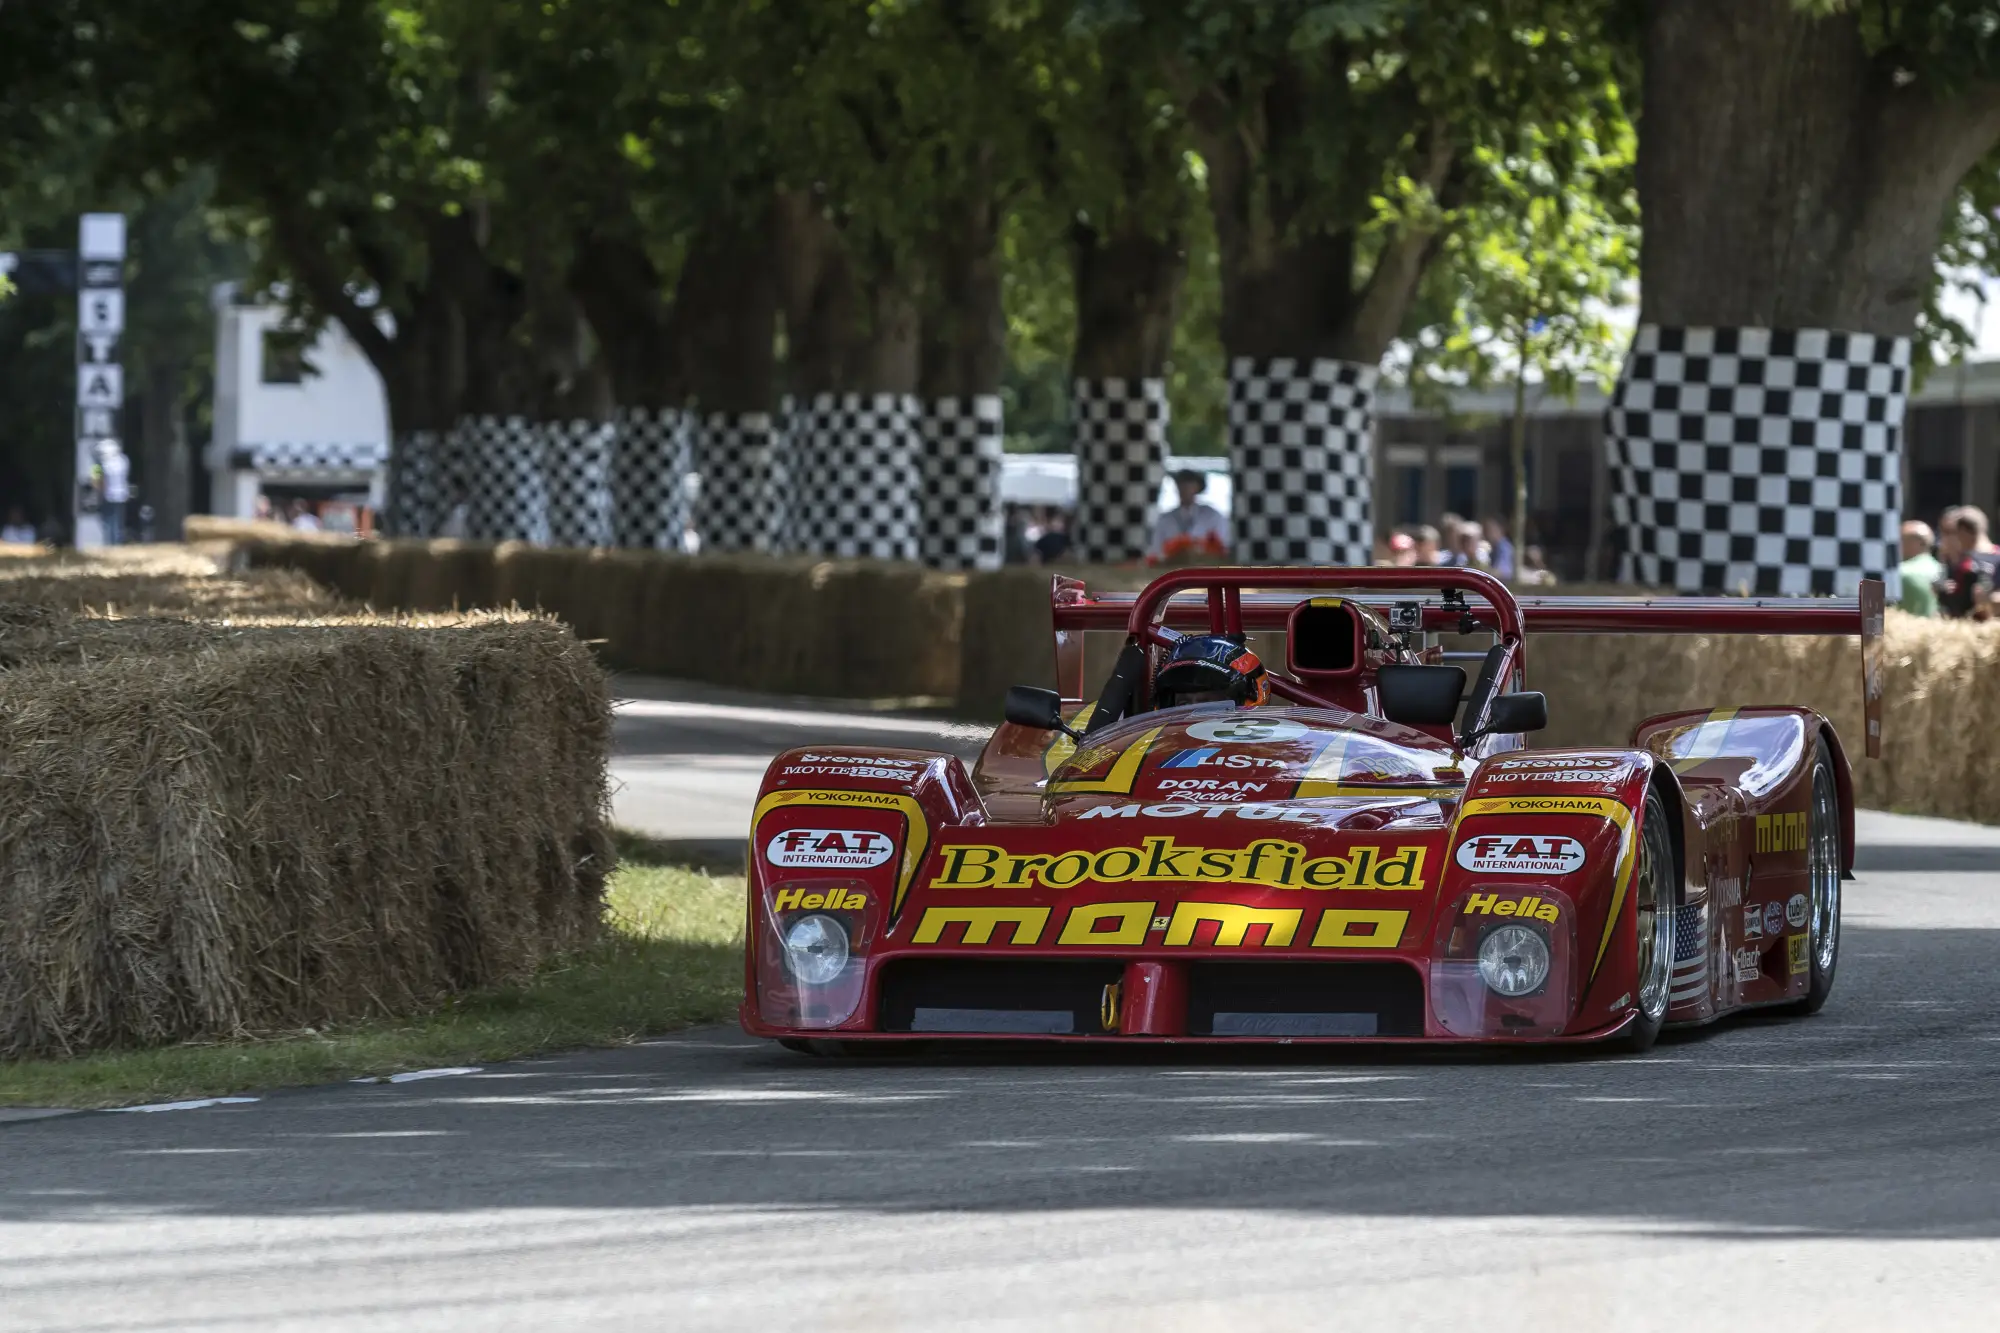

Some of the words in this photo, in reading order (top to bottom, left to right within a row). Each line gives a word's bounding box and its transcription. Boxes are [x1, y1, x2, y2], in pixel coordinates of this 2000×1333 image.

[1210, 718, 1281, 742] 3
[801, 754, 913, 767] brembo
[1198, 753, 1288, 768] LISTA
[1500, 758, 1614, 769] brembo
[1156, 779, 1268, 793] DORAN
[808, 792, 901, 805] YOKOHAMA
[1508, 800, 1603, 810] YOKOHAMA
[1077, 804, 1317, 822] MOTUL
[1755, 811, 1806, 854] momo
[784, 832, 880, 853] F.A.T.
[1474, 838, 1573, 859] F.A.T.
[782, 855, 875, 865] INTERNATIONAL
[931, 836, 1427, 891] Brooksfield
[1473, 860, 1567, 871] INTERNATIONAL
[774, 889, 867, 913] Hella
[1463, 893, 1560, 924] Hella
[911, 902, 1411, 948] momo
